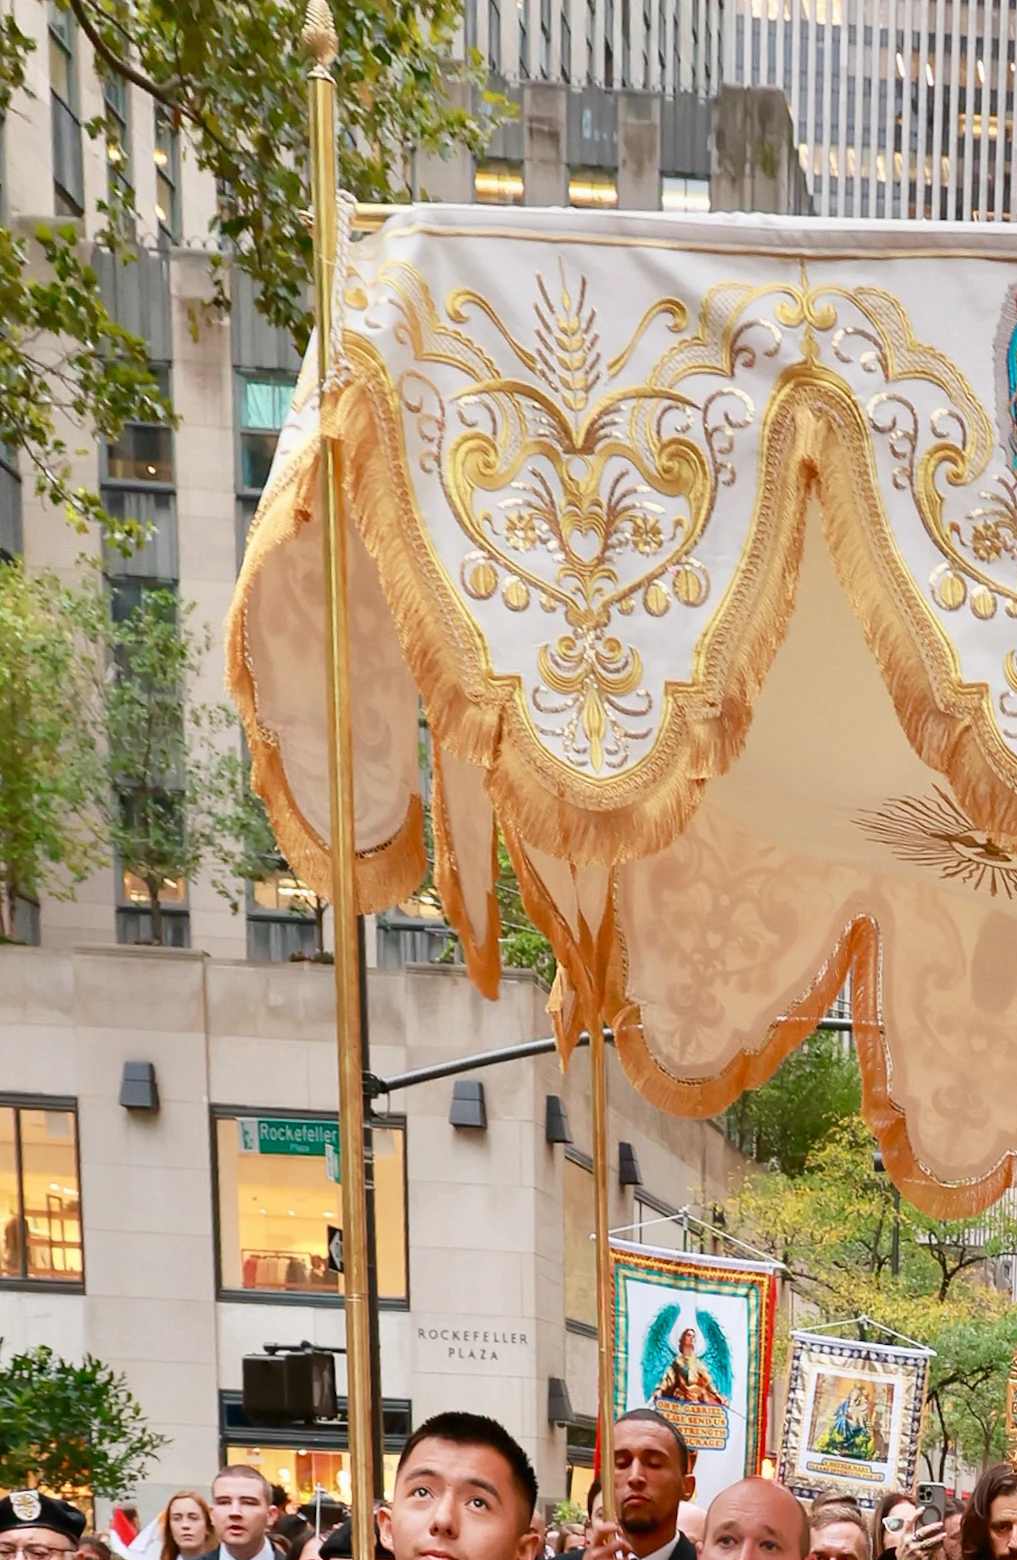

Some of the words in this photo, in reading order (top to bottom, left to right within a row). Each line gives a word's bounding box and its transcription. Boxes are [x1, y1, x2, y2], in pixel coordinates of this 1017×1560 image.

[260, 1122, 337, 1143] Rockefeller
[417, 1327, 527, 1344] ROCKEFELLER
[448, 1347, 498, 1361] PLAZA
